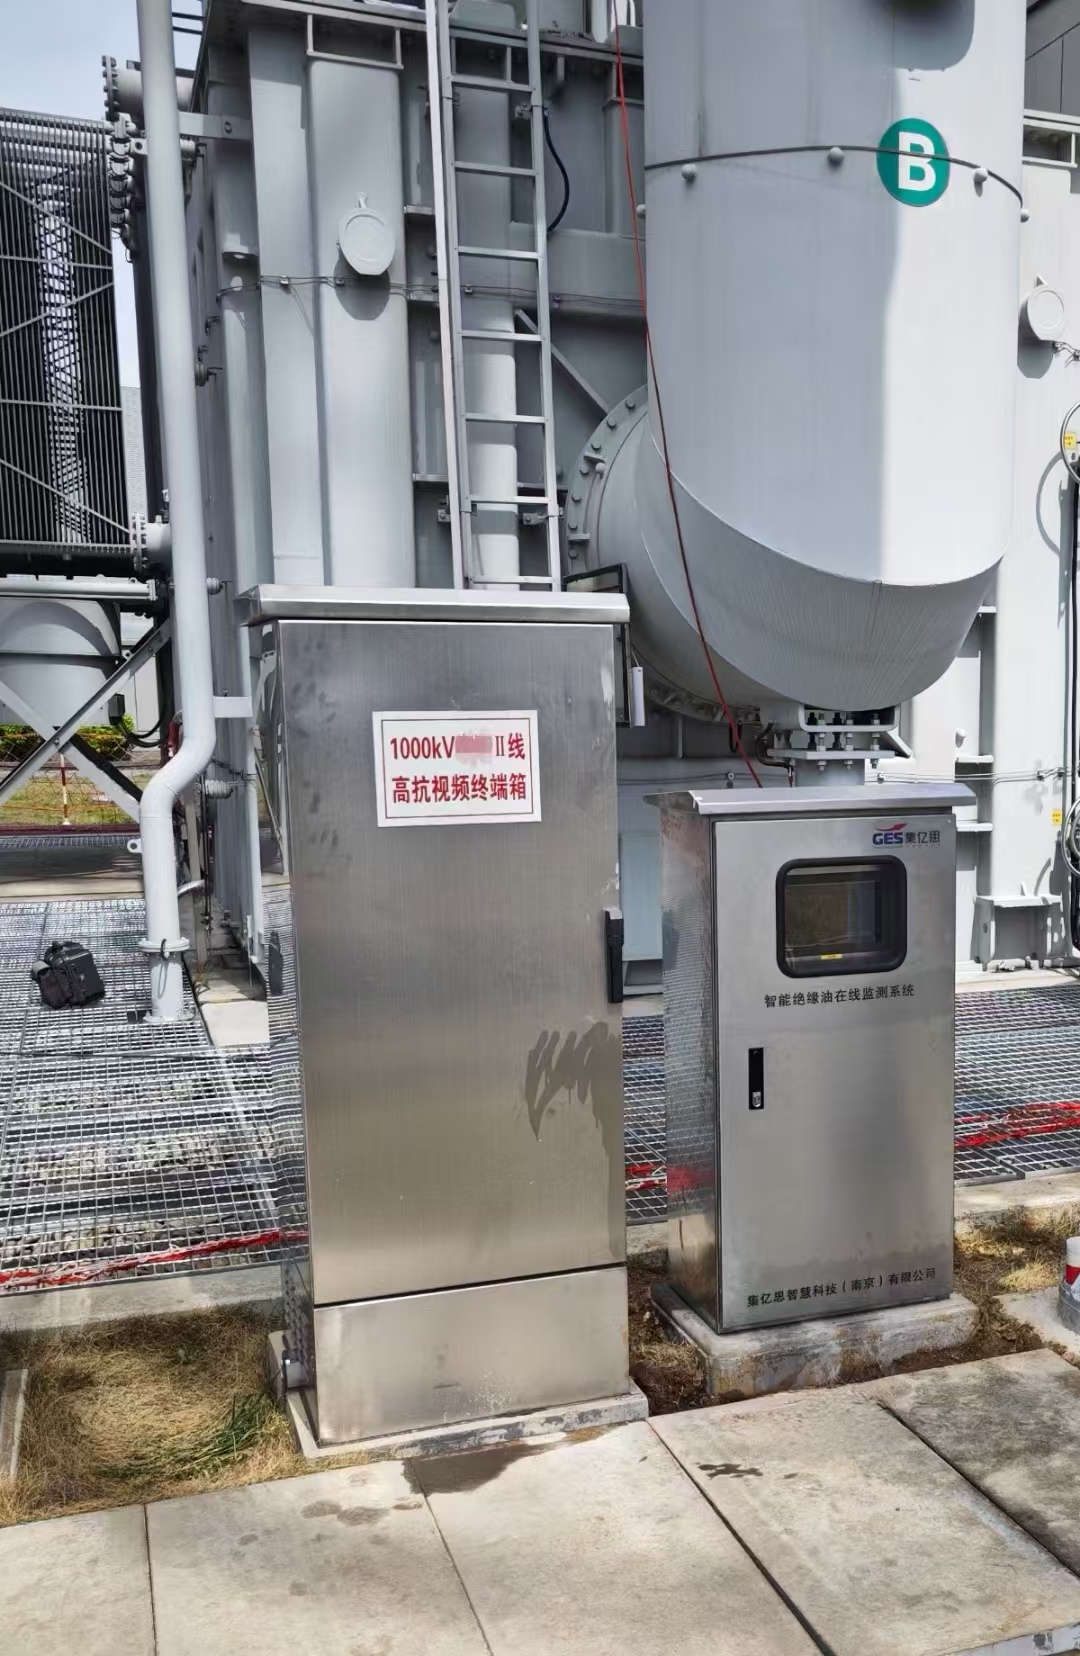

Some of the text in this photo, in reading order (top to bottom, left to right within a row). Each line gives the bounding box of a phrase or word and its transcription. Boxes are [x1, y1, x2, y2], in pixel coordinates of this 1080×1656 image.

[898, 131, 936, 191] B
[390, 735, 456, 760] 1000kV
[391, 772, 527, 804] 高抗视频终端箱
[872, 832, 904, 846] GES
[763, 983, 916, 1009] 智能绝缘油在线监测系统
